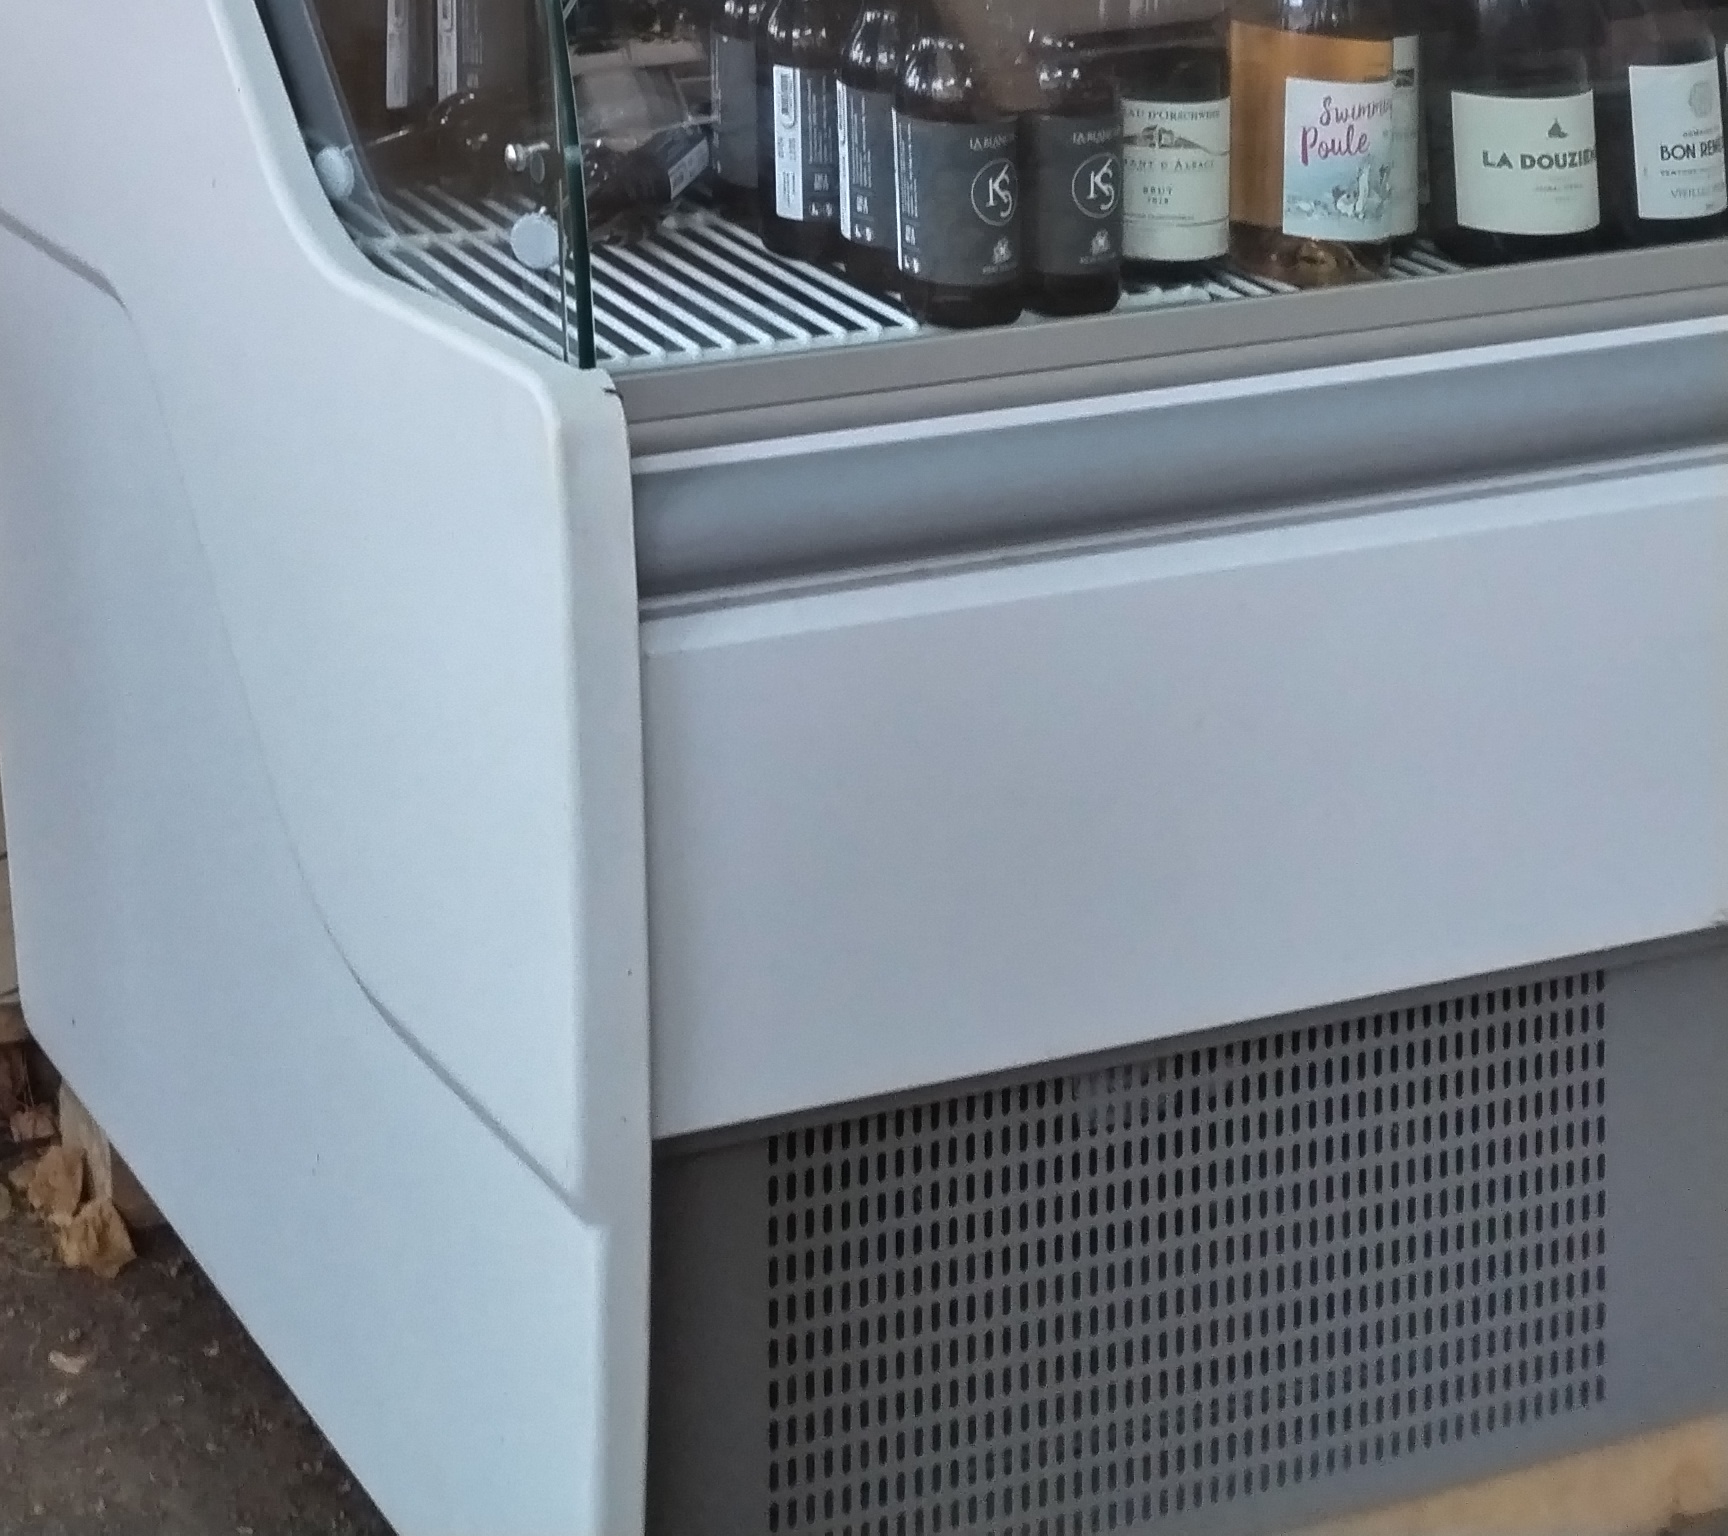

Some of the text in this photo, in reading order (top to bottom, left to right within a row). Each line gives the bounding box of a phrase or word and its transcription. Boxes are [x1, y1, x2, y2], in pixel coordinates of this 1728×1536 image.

[1300, 123, 1370, 167] Poule
[1660, 143, 1696, 161] BON
[1482, 149, 1513, 169] LA
